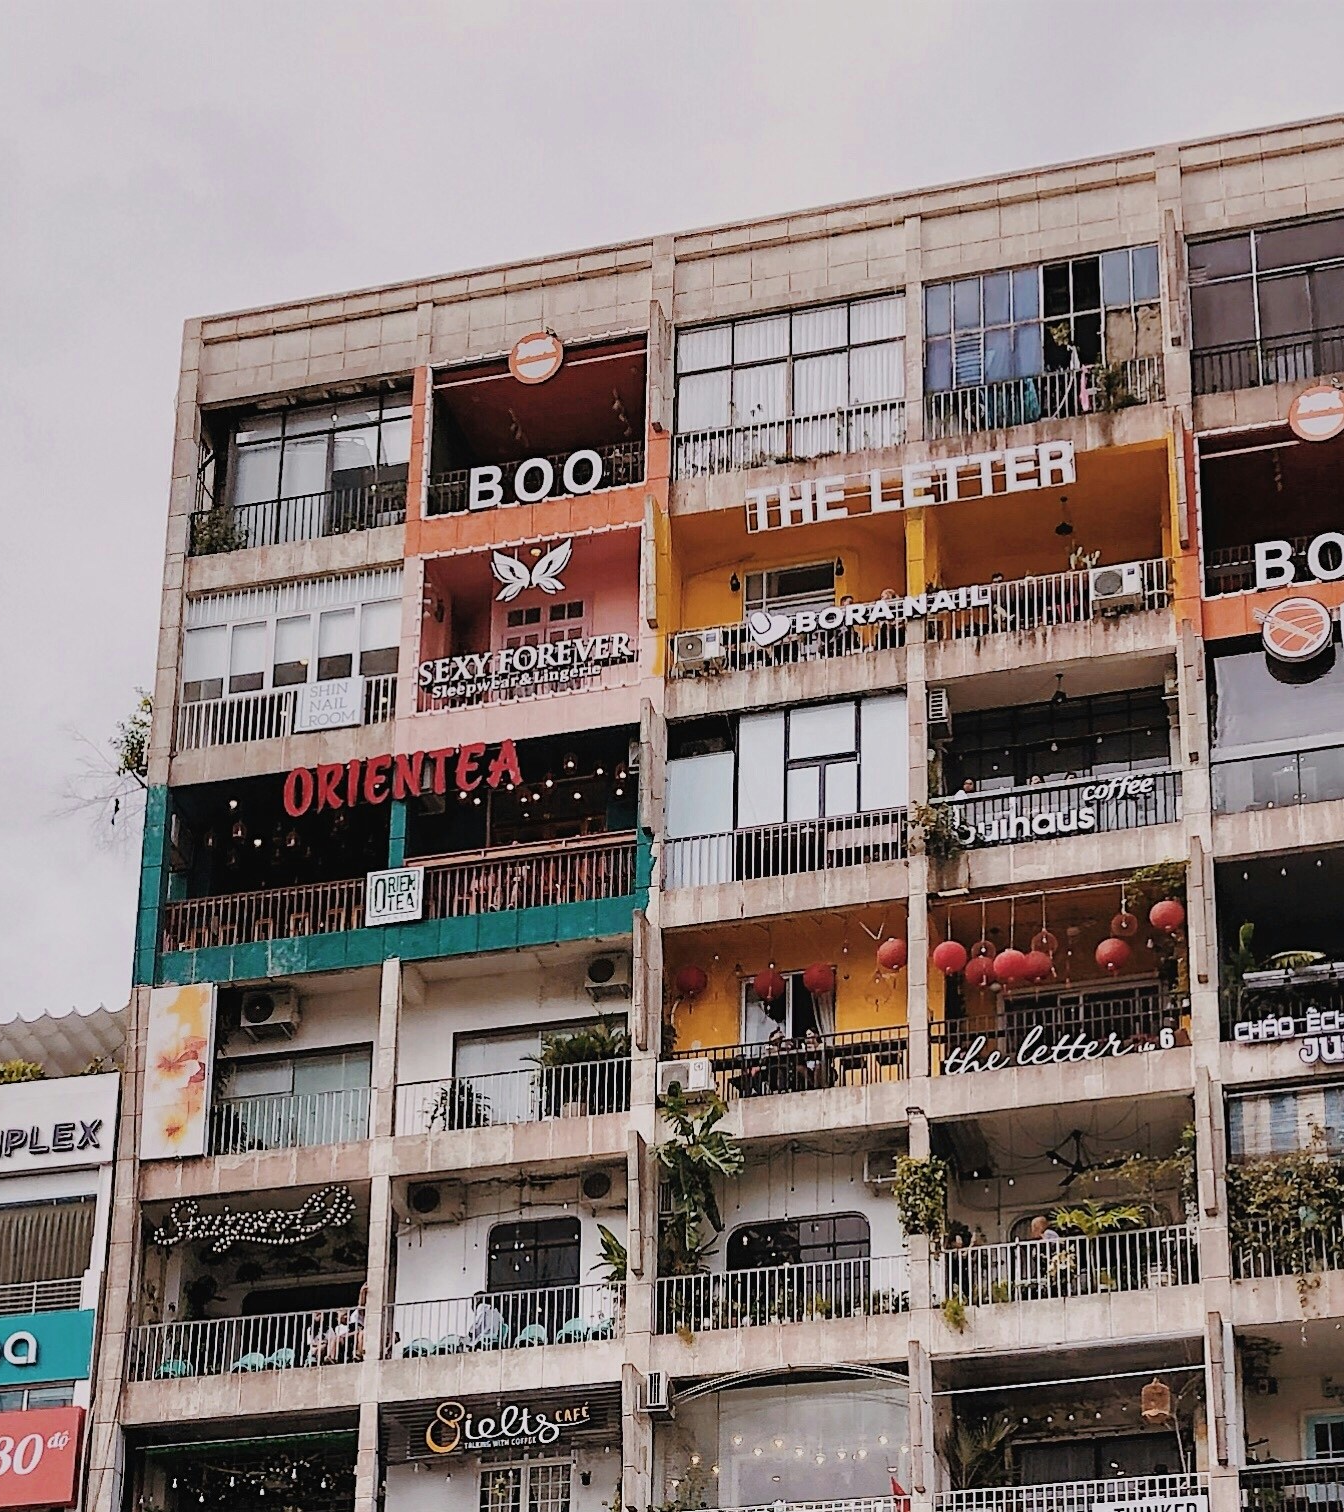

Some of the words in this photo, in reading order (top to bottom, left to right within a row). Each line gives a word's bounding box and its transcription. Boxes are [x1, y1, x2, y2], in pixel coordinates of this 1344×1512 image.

[469, 449, 602, 510] BOO
[747, 474, 848, 533] THE
[870, 440, 1077, 512] LETTER
[795, 605, 896, 634] BORA
[904, 584, 990, 619] NAIL
[419, 652, 492, 687] SEXY
[499, 632, 633, 673] FOREVER
[309, 681, 349, 699] SHIN
[309, 697, 348, 714] NAIL
[308, 709, 356, 728] ROOM
[284, 738, 523, 817] ORIENTEA
[1082, 777, 1155, 801] coffee
[387, 893, 414, 911] TEA
[1234, 1014, 1294, 1041] CHÁO
[944, 1035, 1009, 1076] the
[1017, 1024, 1134, 1065] letter
[1160, 1028, 1174, 1049] 6
